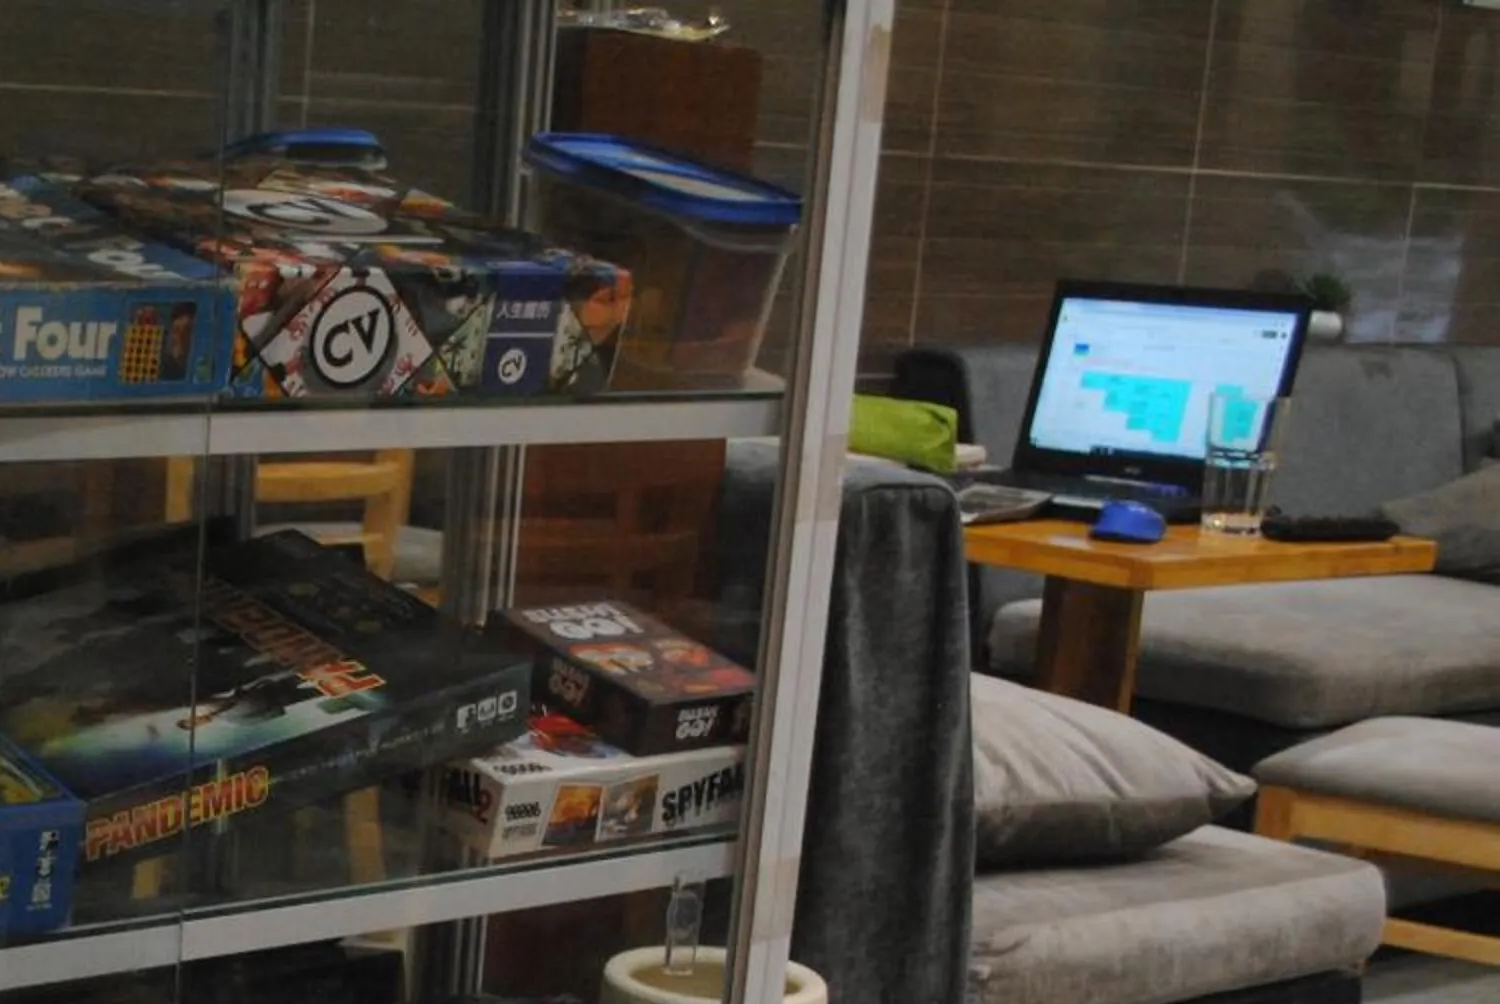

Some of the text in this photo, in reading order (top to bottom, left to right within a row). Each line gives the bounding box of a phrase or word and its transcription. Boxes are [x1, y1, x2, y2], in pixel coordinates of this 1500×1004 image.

[13, 305, 115, 360] Four
[322, 308, 381, 368] CV
[85, 764, 270, 863] PANDEMIC
